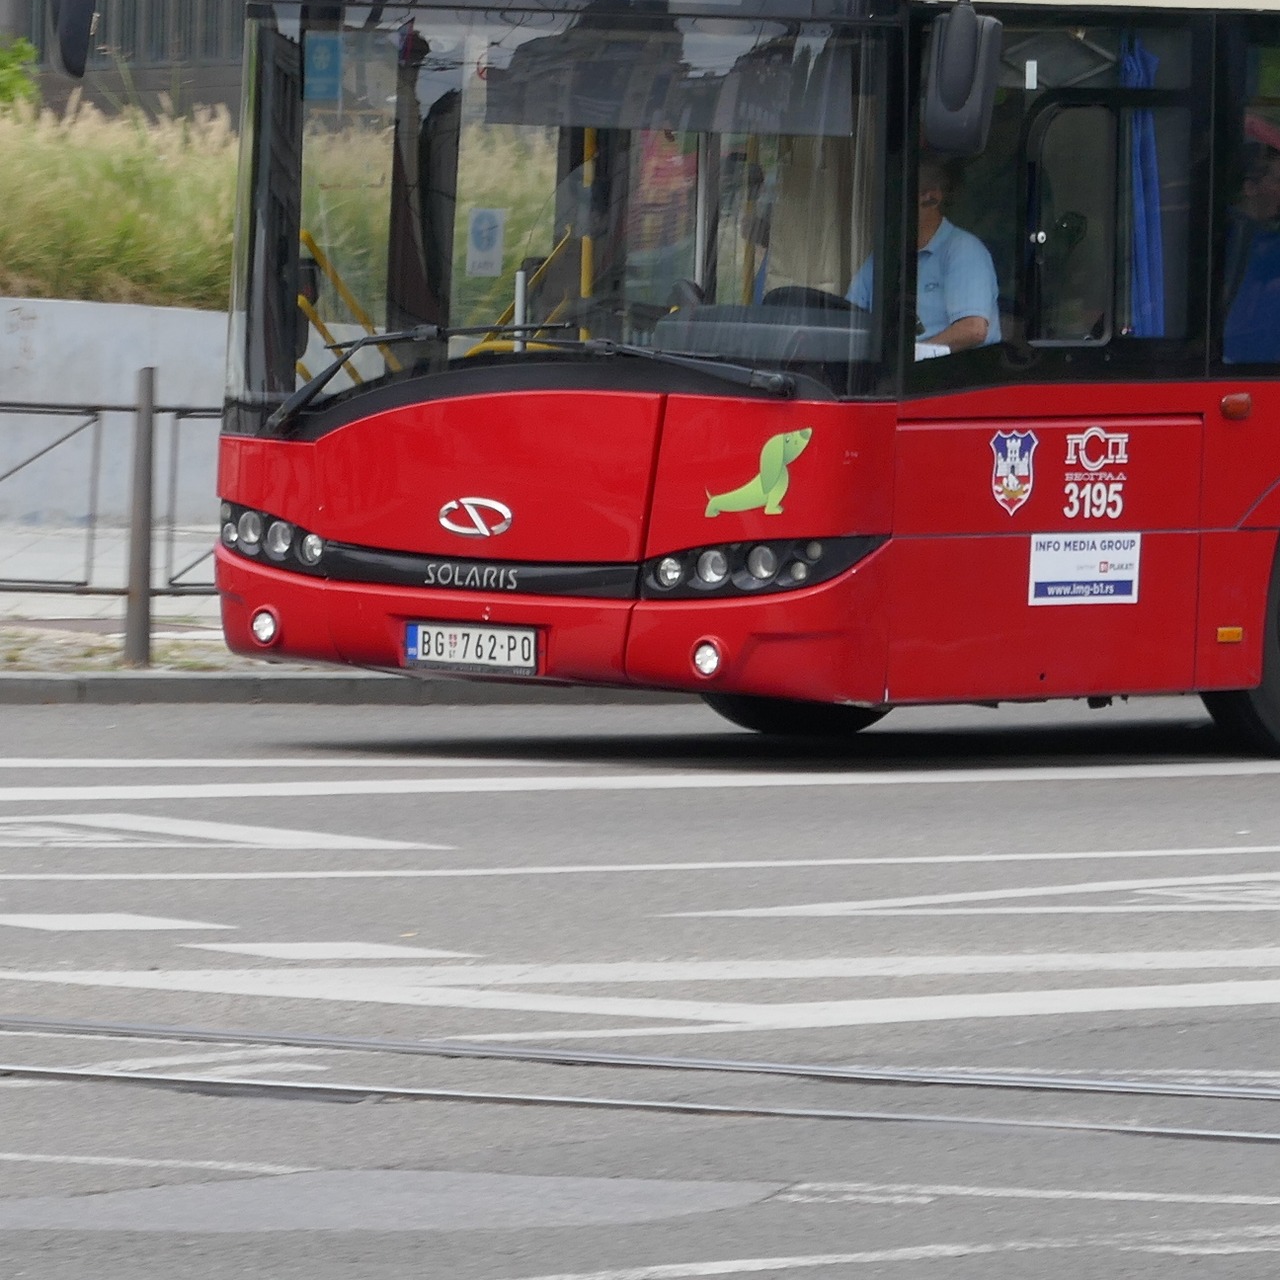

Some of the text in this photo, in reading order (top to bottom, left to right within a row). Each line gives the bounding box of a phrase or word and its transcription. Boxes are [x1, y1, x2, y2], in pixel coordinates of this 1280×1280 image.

[1063, 483, 1124, 519] 3195
[1035, 539, 1136, 552] INFO MEDIA GROUP
[424, 563, 519, 590] SOLARIS
[1047, 583, 1115, 598] www.img-b1.rs
[421, 630, 445, 657] BG
